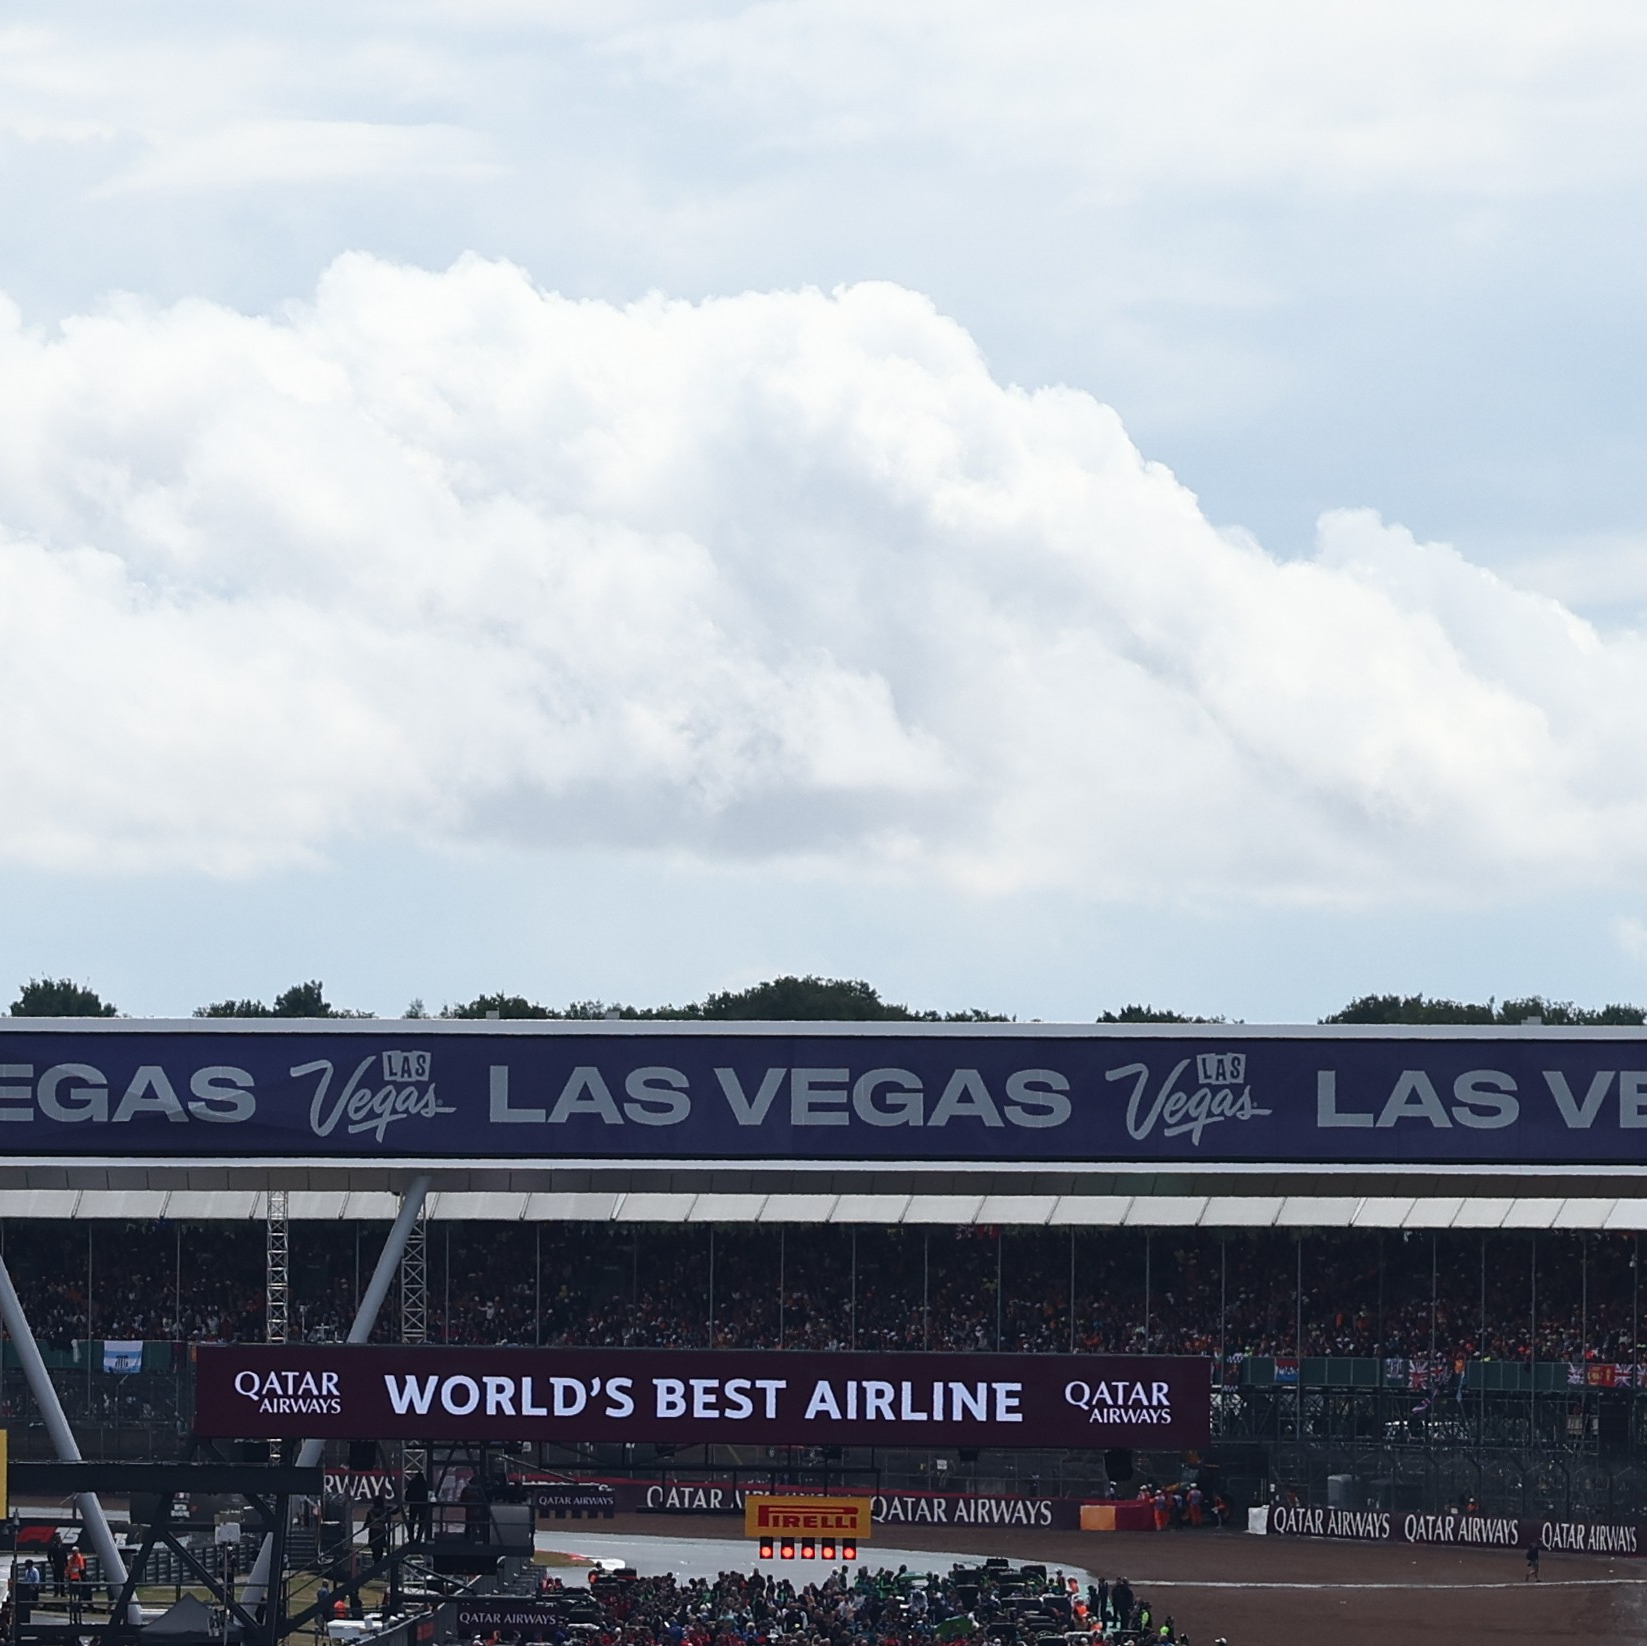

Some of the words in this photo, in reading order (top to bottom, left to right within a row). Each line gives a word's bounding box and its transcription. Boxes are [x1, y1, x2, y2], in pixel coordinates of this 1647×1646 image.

[384, 1051, 430, 1081] LAS
[1199, 1054, 1244, 1083] LAS
[290, 1056, 456, 1142] Vegas
[489, 1065, 691, 1126] LAS
[714, 1066, 1072, 1128] VEGAS
[1106, 1059, 1272, 1146] Vegas
[1317, 1069, 1519, 1129] LAS
[234, 1371, 341, 1401] QATAR
[383, 1374, 635, 1419] WORLD'S
[654, 1377, 787, 1421] BEST
[804, 1379, 1024, 1423] AIRLINE
[1065, 1381, 1171, 1411] QATAR
[259, 1398, 341, 1415] AIRWAYS
[1089, 1408, 1172, 1425] AIRWAYS
[539, 1496, 571, 1505] QATAR
[572, 1496, 614, 1505] AIRWAYS
[647, 1486, 723, 1508] QATAR
[871, 1497, 946, 1523] QATAR
[954, 1499, 1052, 1526] AIRWAYS
[758, 1505, 859, 1529] PIRELLI
[1274, 1507, 1323, 1534] QATAR
[1328, 1510, 1390, 1538] AIRWAYS
[1404, 1514, 1454, 1543] QATAR
[1458, 1516, 1519, 1545] AIRWAYS
[1542, 1522, 1585, 1551] QATAR
[1587, 1525, 1636, 1553] AIRWAYS
[459, 1612, 501, 1623] QATAR
[504, 1614, 556, 1625] AIRWAYS
